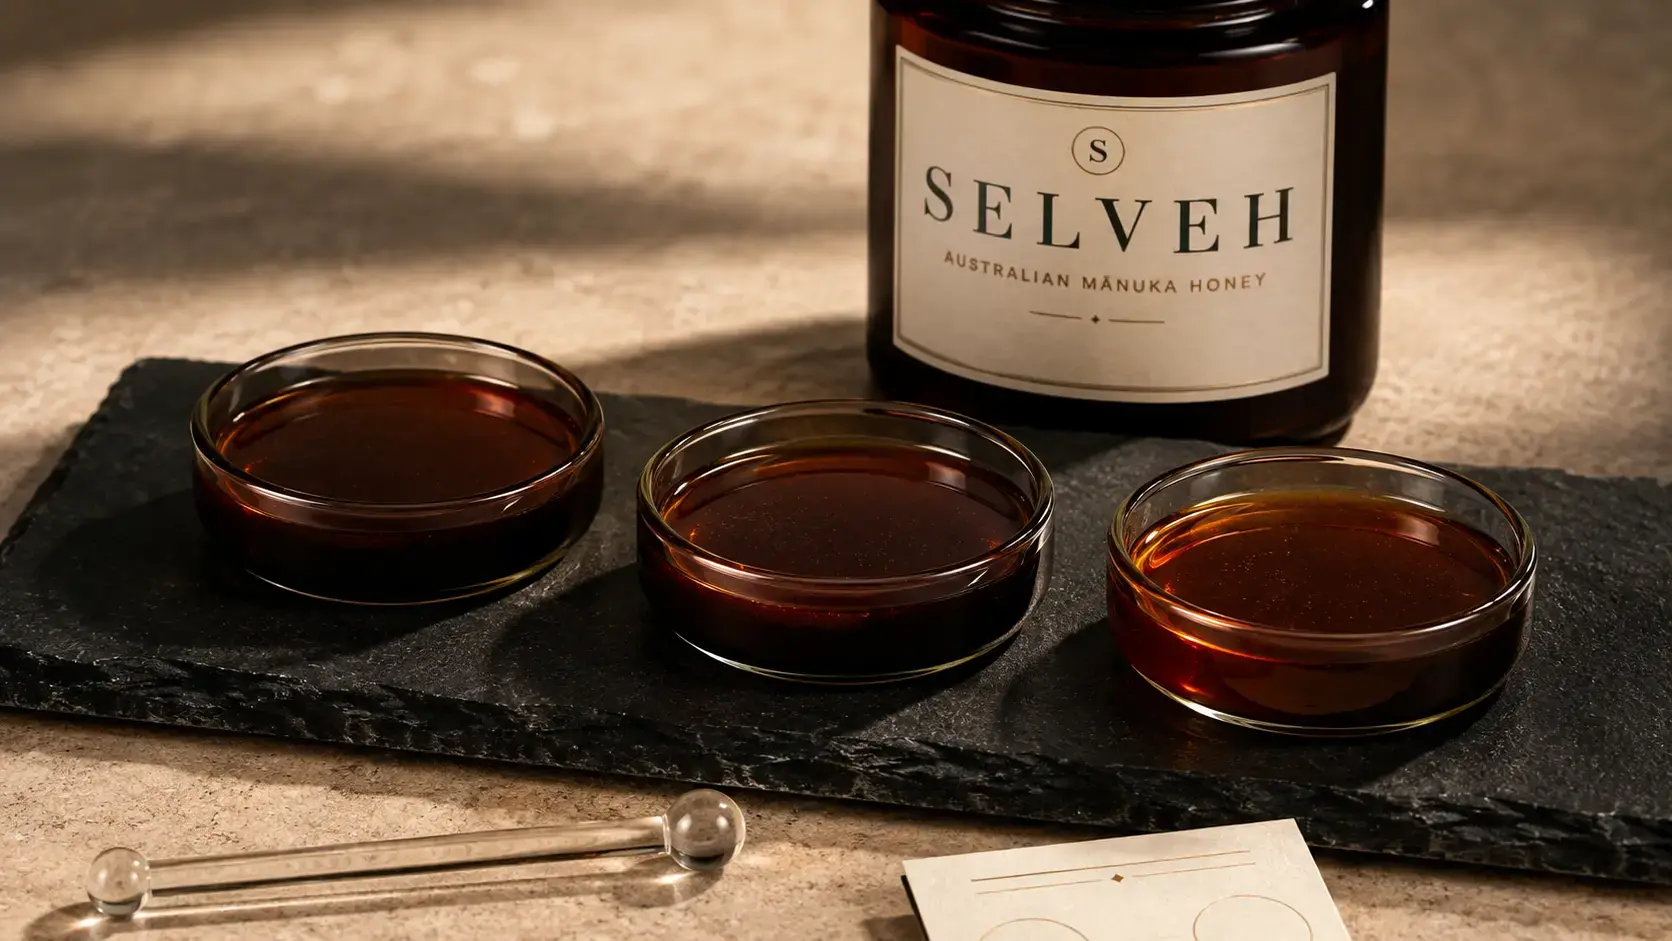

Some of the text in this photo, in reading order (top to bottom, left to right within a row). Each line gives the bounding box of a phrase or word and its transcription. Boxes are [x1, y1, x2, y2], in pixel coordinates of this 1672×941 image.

[1088, 138, 1109, 164] S
[923, 165, 1296, 254] SELVEH
[943, 250, 1268, 294] AUSTRALIAN MĀNUKA HONEY
